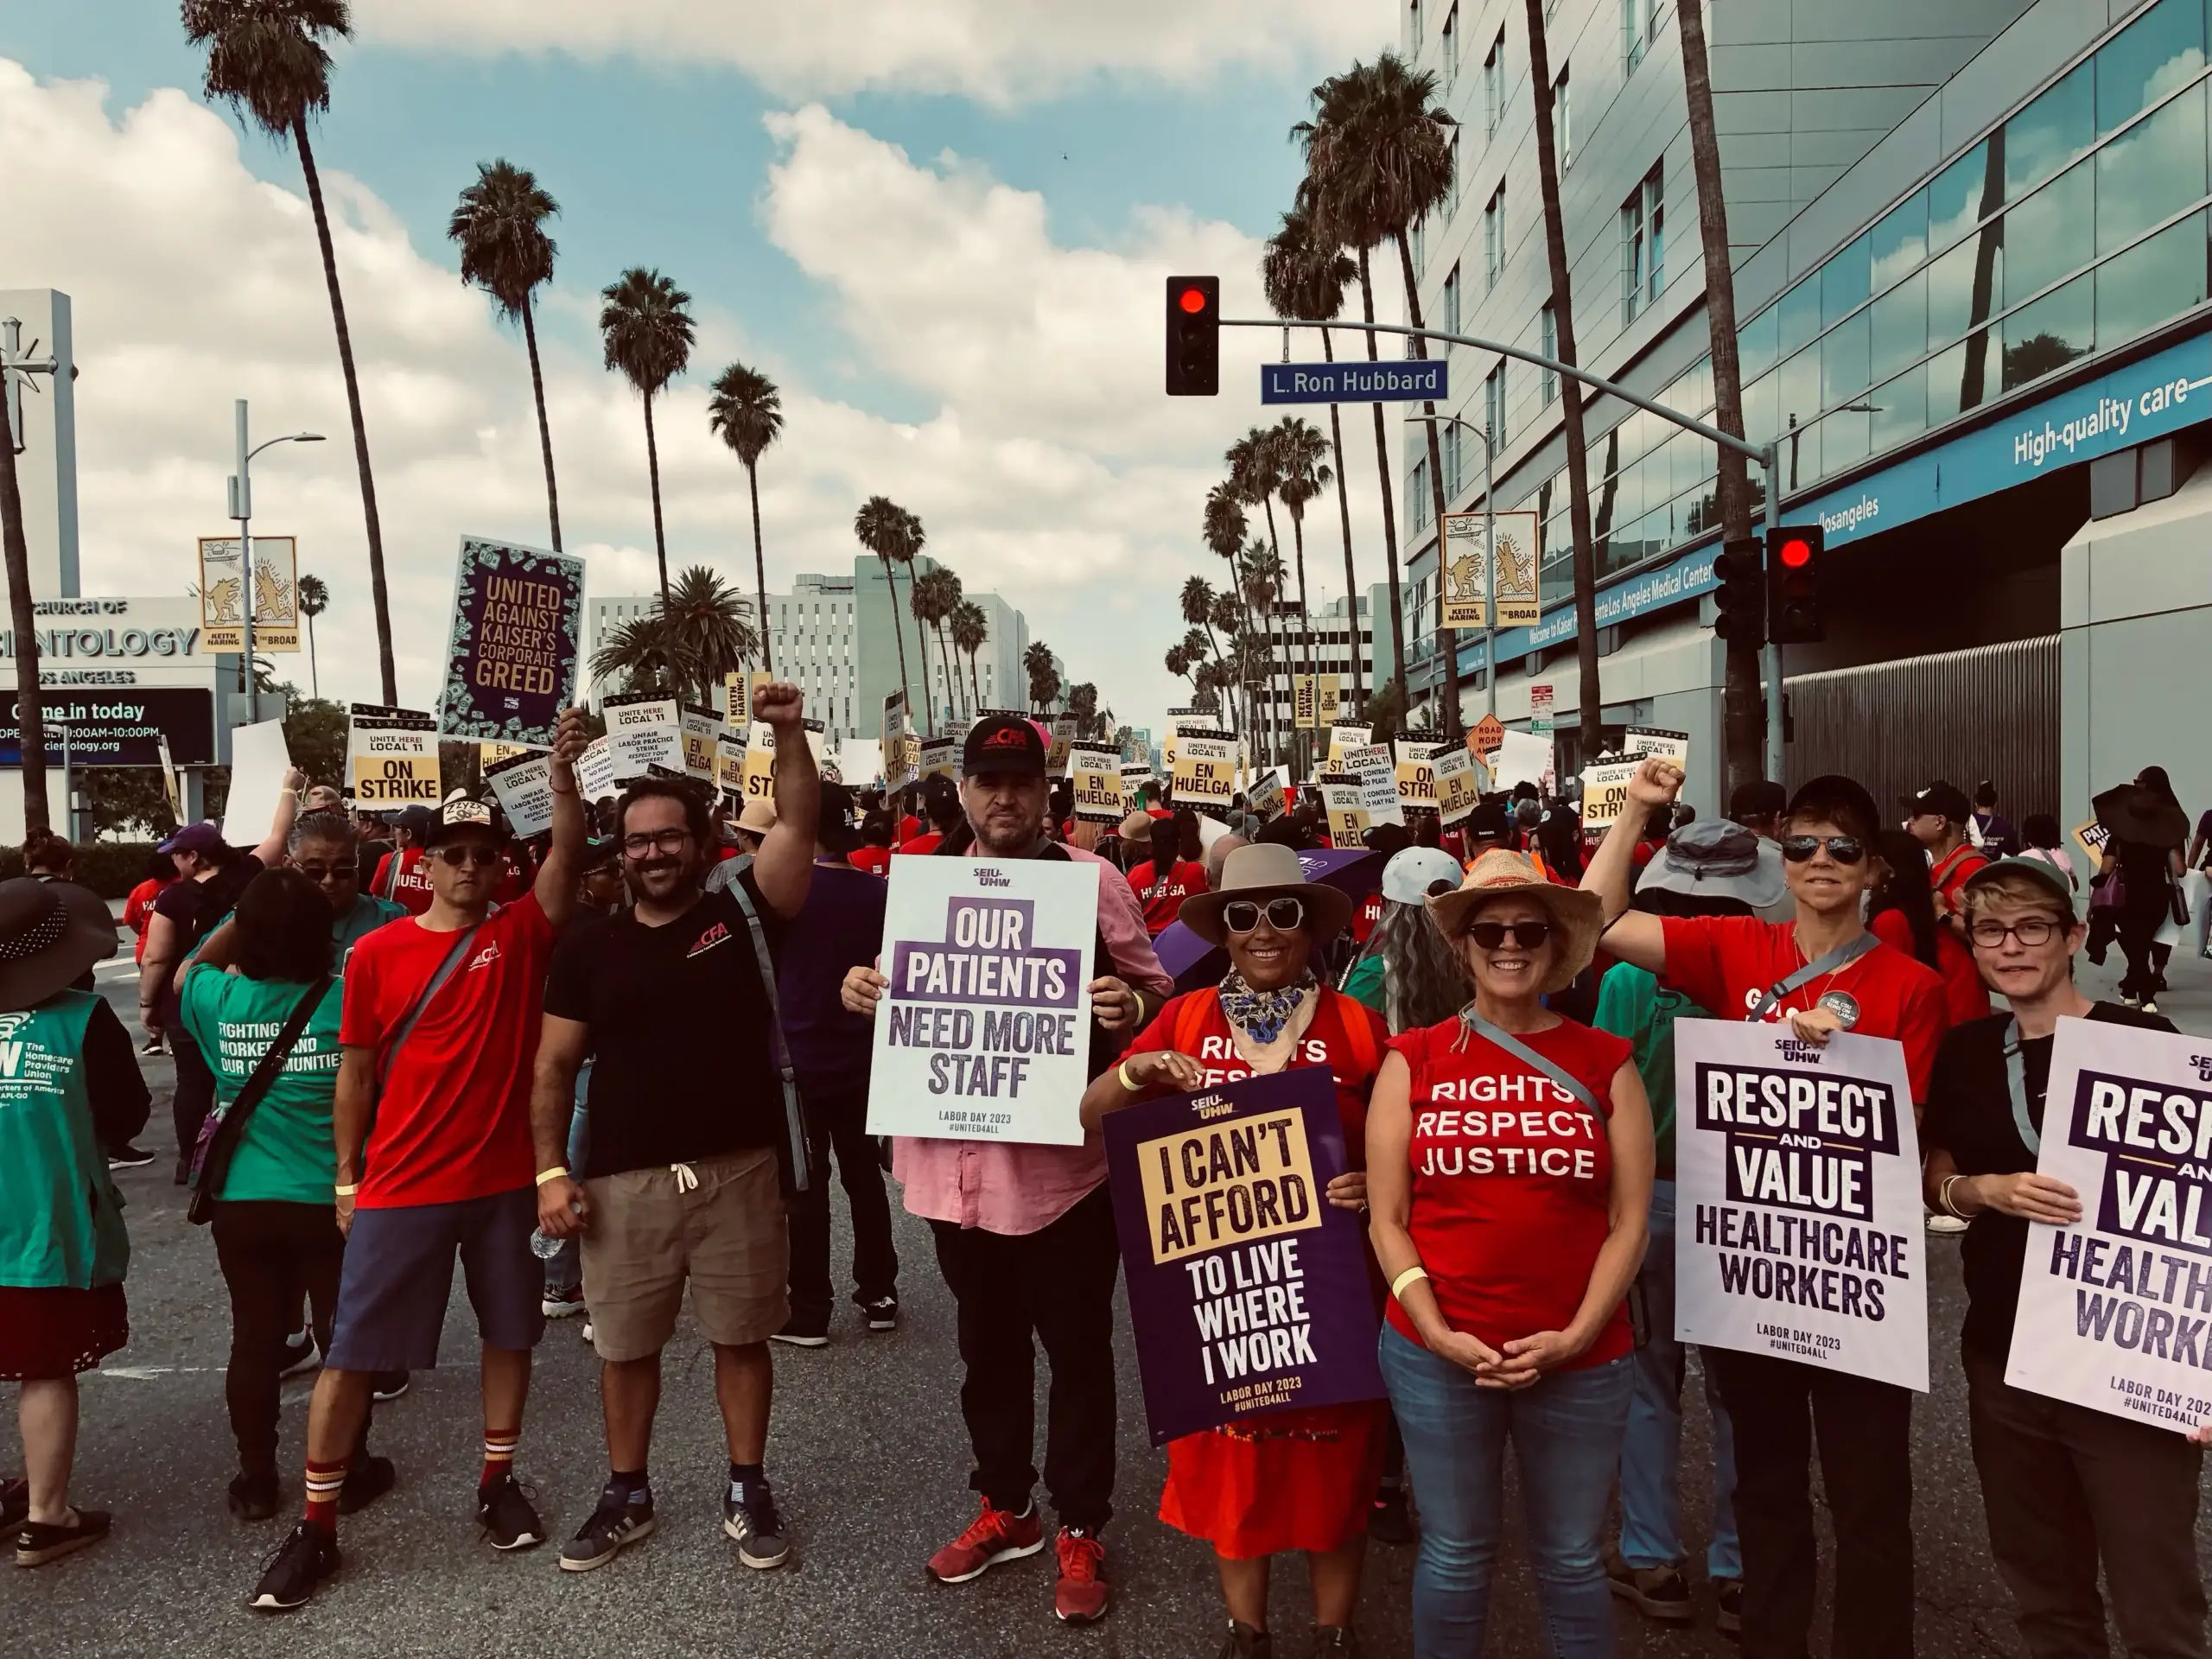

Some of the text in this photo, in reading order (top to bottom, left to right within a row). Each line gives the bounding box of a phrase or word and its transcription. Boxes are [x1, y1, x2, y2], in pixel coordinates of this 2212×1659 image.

[1274, 369, 1436, 392] L. Ron Hubbard
[2015, 398, 2133, 466] High-quality
[486, 575, 560, 610] UNITED
[102, 601, 127, 614] OF
[1529, 563, 1713, 645] Welcome to Kaiser Los Angeles Medical Center
[482, 601, 559, 631] AGAINST
[1508, 610, 1537, 619] BROAD
[268, 636, 296, 645] BROAD
[480, 623, 556, 651] KAISER'S
[478, 643, 556, 668] CORPORATE
[60, 671, 136, 684] ANGELES
[476, 659, 555, 694] GREED
[69, 702, 144, 721] in today
[620, 715, 652, 725] LOCAL
[643, 736, 674, 745] PRACTICE
[690, 739, 702, 753] EN
[1637, 745, 1662, 753] LOCAL
[580, 748, 607, 764] LOCAL
[1188, 748, 1215, 757] LOCAL
[1344, 747, 1387, 760] UNITEHERE!
[384, 760, 412, 779] ON
[730, 761, 740, 772] EN
[1196, 764, 1214, 778] EN
[1346, 758, 1379, 769] LOCAL
[1363, 767, 1390, 777] CONTRACT
[504, 765, 543, 782] UNITE HERE!
[360, 779, 437, 798] STRIKE
[506, 776, 536, 789] LOCAL
[1090, 776, 1104, 790] EN
[1175, 777, 1230, 795] HUELGA
[1450, 778, 1462, 794] EN
[520, 788, 544, 800] UNFAIR
[1076, 789, 1121, 806] HUELGA
[1367, 788, 1395, 798] CONTRATO
[1605, 786, 1626, 803] ON
[511, 799, 531, 810] LABOR
[528, 801, 550, 812] STRIKE
[1262, 795, 1274, 809] ON
[1440, 789, 1478, 815] HUELGA
[524, 809, 543, 819] RESPECT
[843, 809, 854, 826] LA
[1344, 813, 1358, 829] EN
[973, 868, 1002, 877] SEIU-
[979, 877, 1010, 887] UHW
[701, 922, 728, 944] CFA
[955, 906, 1024, 950] OUR
[906, 951, 1066, 1000] PATIENTS
[1828, 997, 1852, 1009] THE CSU
[1838, 1011, 1856, 1021] LABOR
[218, 1022, 279, 1038] FIGHTING
[888, 1006, 1077, 1056] NEED MORE
[289, 1038, 317, 1053] AND
[1775, 1039, 1811, 1050] SEIU-
[26, 1052, 73, 1065] Homecare
[221, 1058, 244, 1074] OUR
[1783, 1051, 1821, 1064] UHW
[24, 1060, 70, 1073] Providers
[24, 1070, 52, 1078] Union
[928, 1052, 1030, 1098] STAFF
[35, 1085, 65, 1095] America
[1431, 1074, 1575, 1103] RIGHTS
[1191, 1094, 1223, 1111] SEIU-
[1707, 1070, 1886, 1142] RESPECT
[938, 1111, 1011, 1124] LABOR DAY 2023
[1200, 1103, 1233, 1120] UHW
[949, 1123, 999, 1134] #UNITED4ALL
[1415, 1110, 1594, 1139] RESPECT
[1779, 1134, 1821, 1149] AND
[1160, 1118, 1294, 1195] I CAN'T
[1421, 1147, 1594, 1179] JUSTICE
[1734, 1145, 1865, 1214] VALUE
[1160, 1174, 1310, 1255] AFFORD
[2115, 1170, 2211, 1249] VAL
[1695, 1204, 1910, 1280] HEALTHCARE
[1185, 1237, 1304, 1300] TO LIVE
[2049, 1230, 2212, 1315] HEALTH
[1719, 1252, 1885, 1322] WORKERS
[1192, 1281, 1310, 1342] WHERE
[1757, 1323, 1840, 1351] LABOR DAY 2023
[2075, 1288, 2212, 1370] WORK
[1201, 1324, 1318, 1385] I WORK
[1770, 1338, 1827, 1360] #UNITED4ALL
[1220, 1376, 1302, 1405] LABOR DAY 2023
[2110, 1376, 2212, 1415] LABOR DAY 202
[1235, 1392, 1291, 1413] #UNITED4ALL
[2123, 1396, 2200, 1428] #UNITED4ALL
